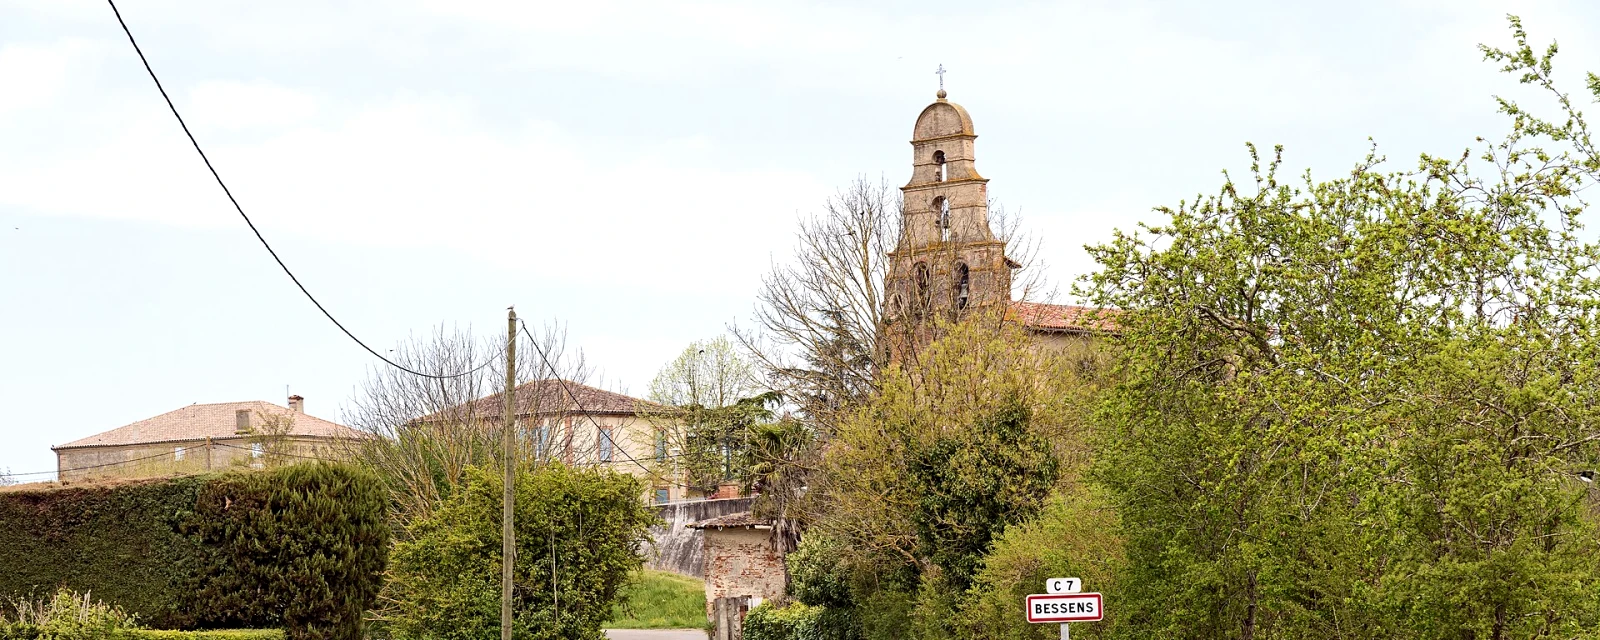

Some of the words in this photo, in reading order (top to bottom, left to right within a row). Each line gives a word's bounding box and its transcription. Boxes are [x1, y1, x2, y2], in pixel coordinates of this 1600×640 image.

[1053, 580, 1062, 591] C
[1066, 580, 1074, 591] 7
[1034, 602, 1094, 614] BESSENS
